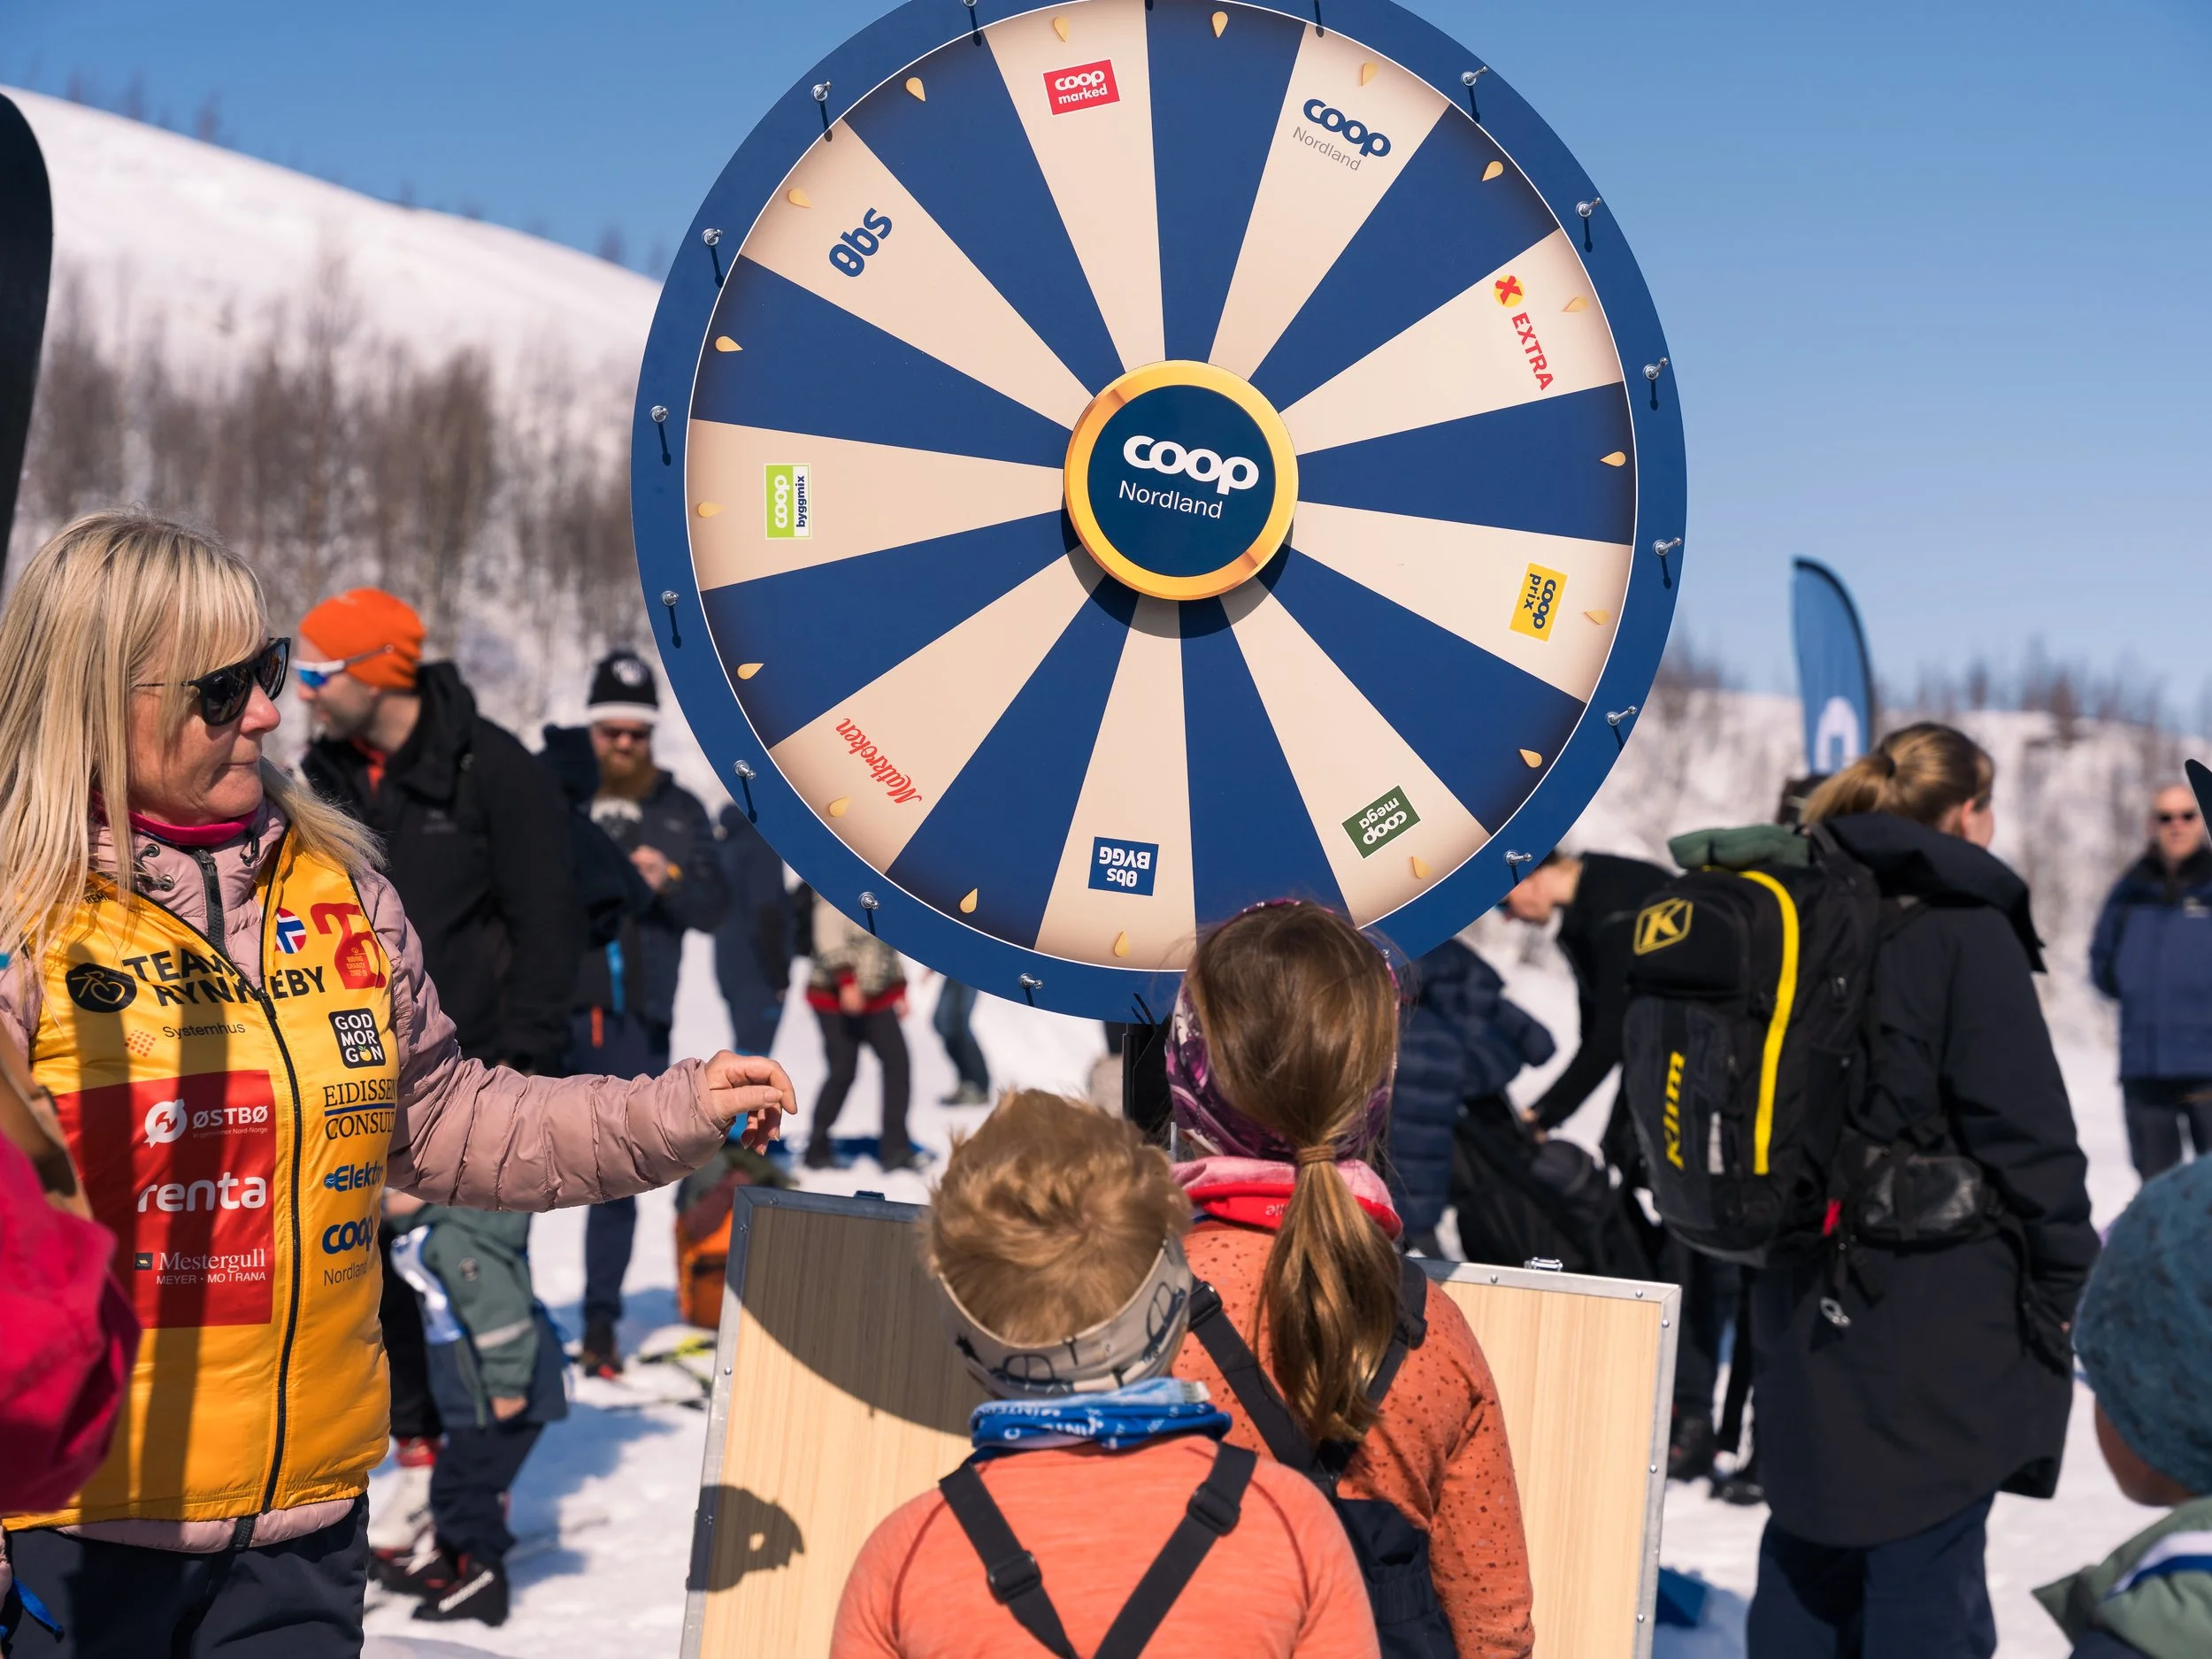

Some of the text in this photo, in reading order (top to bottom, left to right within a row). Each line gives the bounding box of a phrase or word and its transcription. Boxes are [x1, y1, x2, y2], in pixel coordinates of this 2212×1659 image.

[1054, 69, 1105, 91] coop
[1057, 84, 1109, 105] marked
[1302, 98, 1392, 158] coop
[1293, 126, 1363, 172] Nordland
[1511, 311, 1555, 391] EXTRA
[1123, 434, 1260, 495] coop
[773, 473, 791, 529] coop
[795, 474, 807, 528] byggmix
[1118, 480, 1224, 519] Nordland
[1523, 572, 1543, 611] prix
[1532, 578, 1557, 630] coop
[835, 718, 923, 804] Matkroken
[1357, 796, 1402, 830] mega
[1362, 810, 1409, 846] coop
[1098, 846, 1152, 871] BYGG
[122, 948, 235, 982] TEAM
[162, 1022, 247, 1041] Systemhus
[334, 1013, 373, 1031] GOD
[340, 1030, 378, 1047] MOR
[192, 1105, 268, 1129] ØSTBØ
[233, 1126, 268, 1136] Nord-Norge
[137, 1171, 266, 1213] renta
[322, 1216, 374, 1255] coop
[156, 1274, 197, 1285] MEYER
[207, 1272, 226, 1284] MO
[234, 1271, 266, 1282] RANA
[157, 1248, 266, 1274] Mestergull
